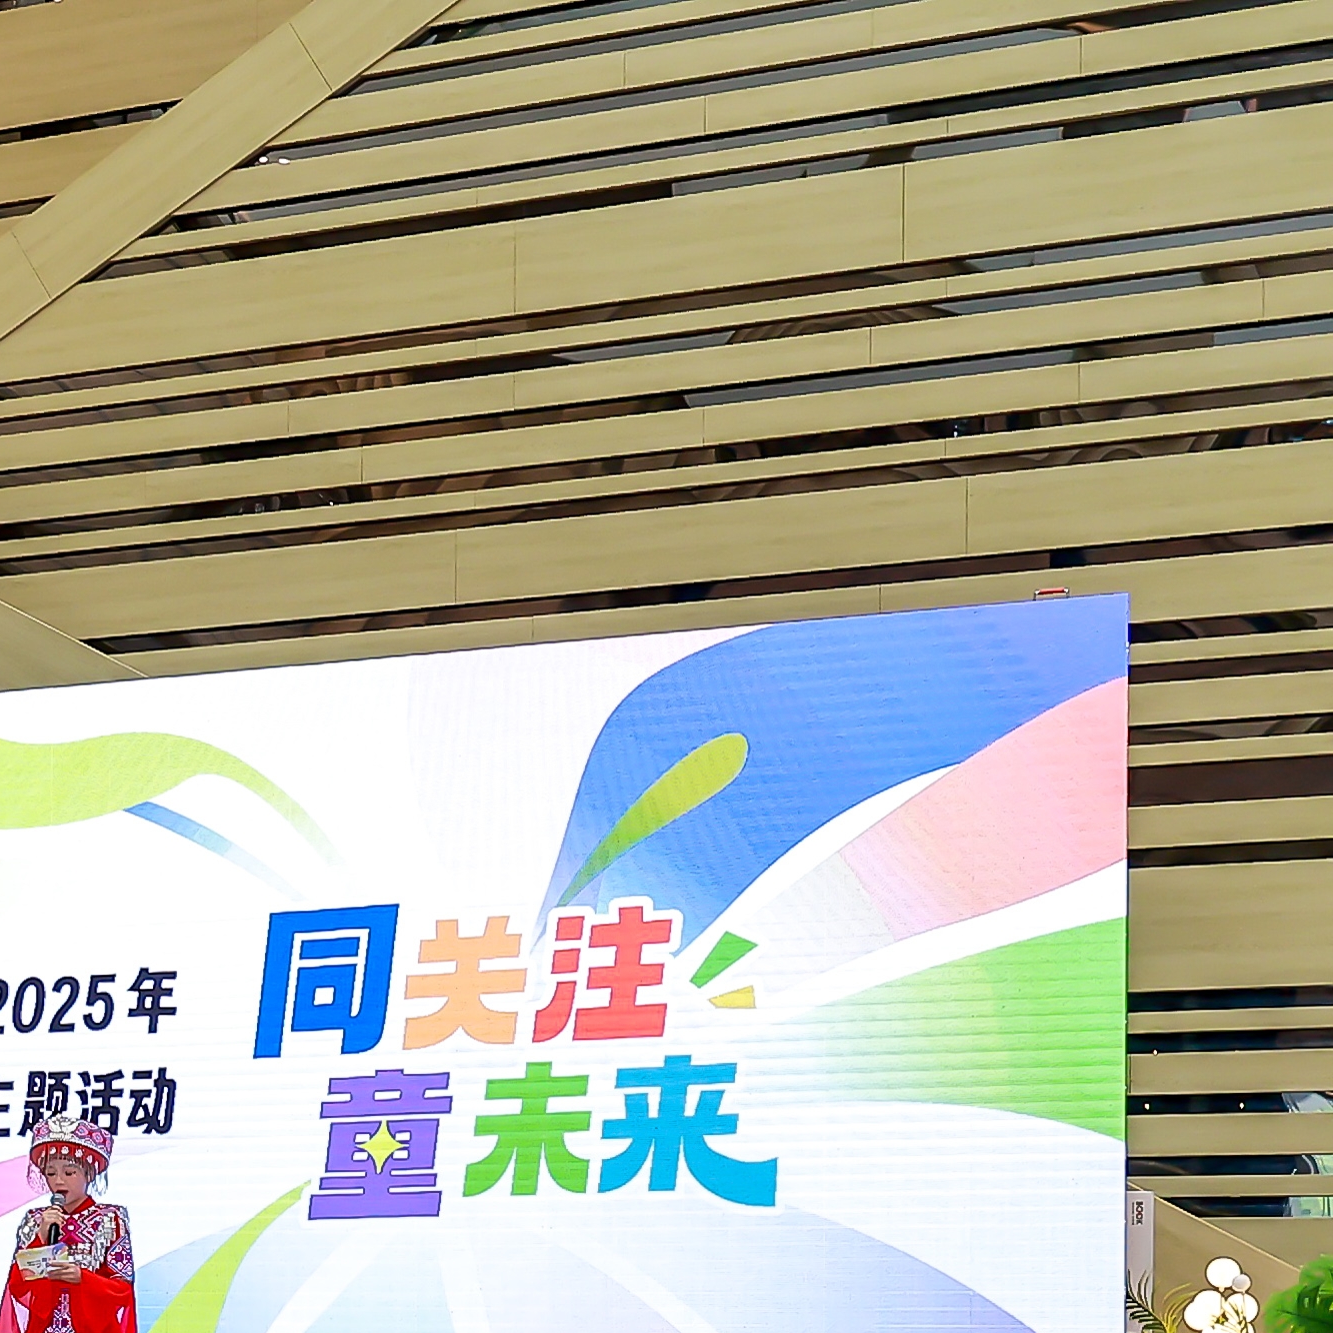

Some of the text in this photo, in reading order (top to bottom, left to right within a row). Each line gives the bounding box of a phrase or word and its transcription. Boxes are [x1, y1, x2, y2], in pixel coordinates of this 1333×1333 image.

[253, 903, 673, 1059] 同关注
[307, 1054, 779, 1220] 童未来
